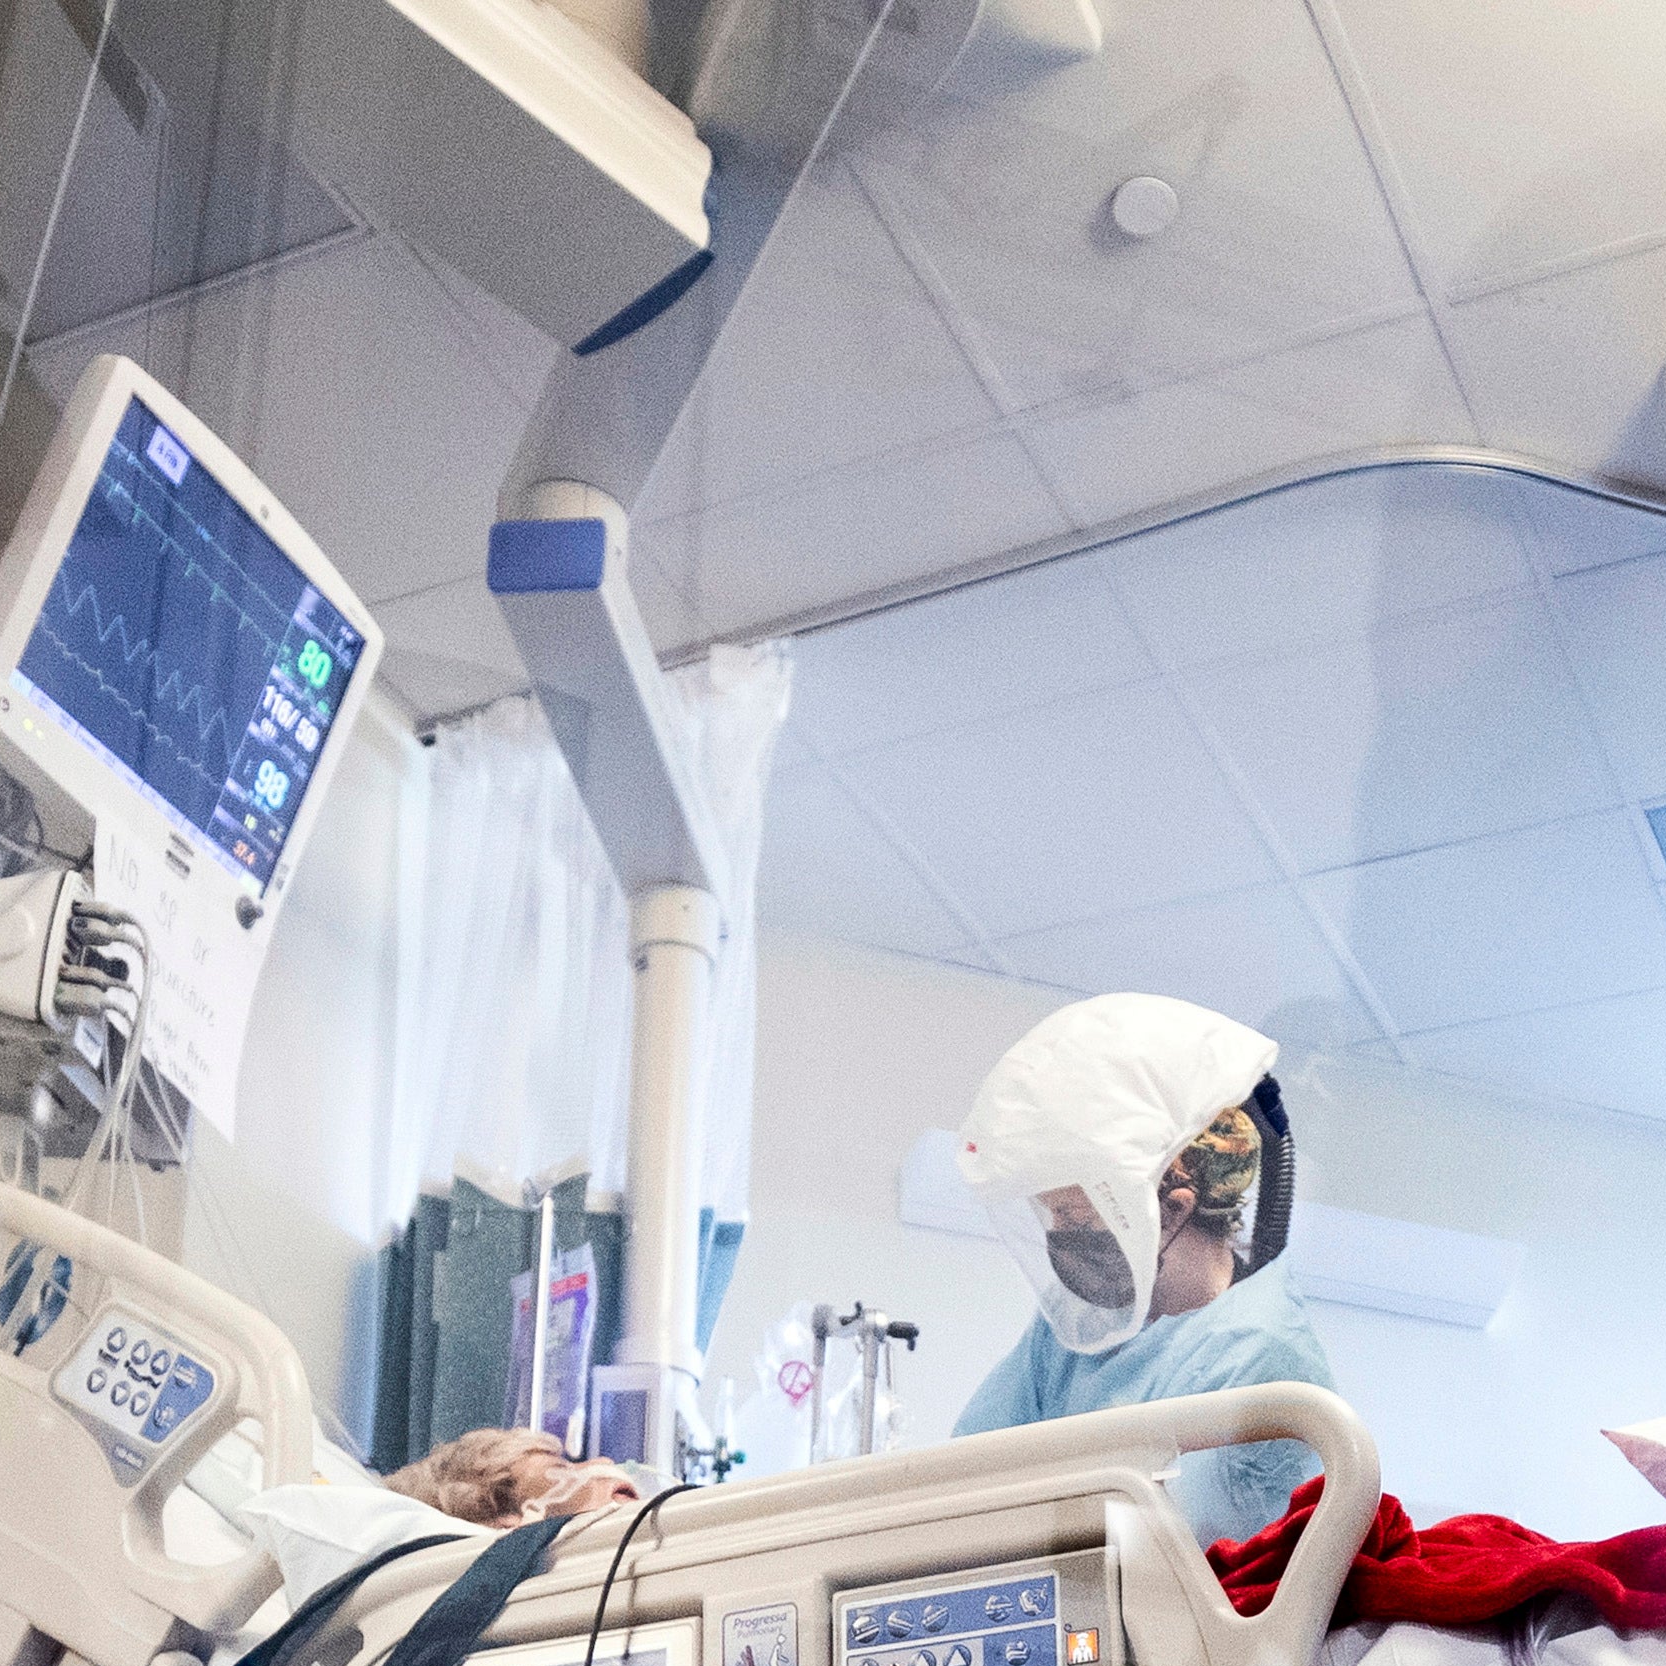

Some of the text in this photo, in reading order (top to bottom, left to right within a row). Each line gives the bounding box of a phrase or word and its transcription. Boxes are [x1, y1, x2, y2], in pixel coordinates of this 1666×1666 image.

[297, 639, 333, 689] 80
[294, 716, 320, 752] 59
[254, 758, 291, 810] 98
